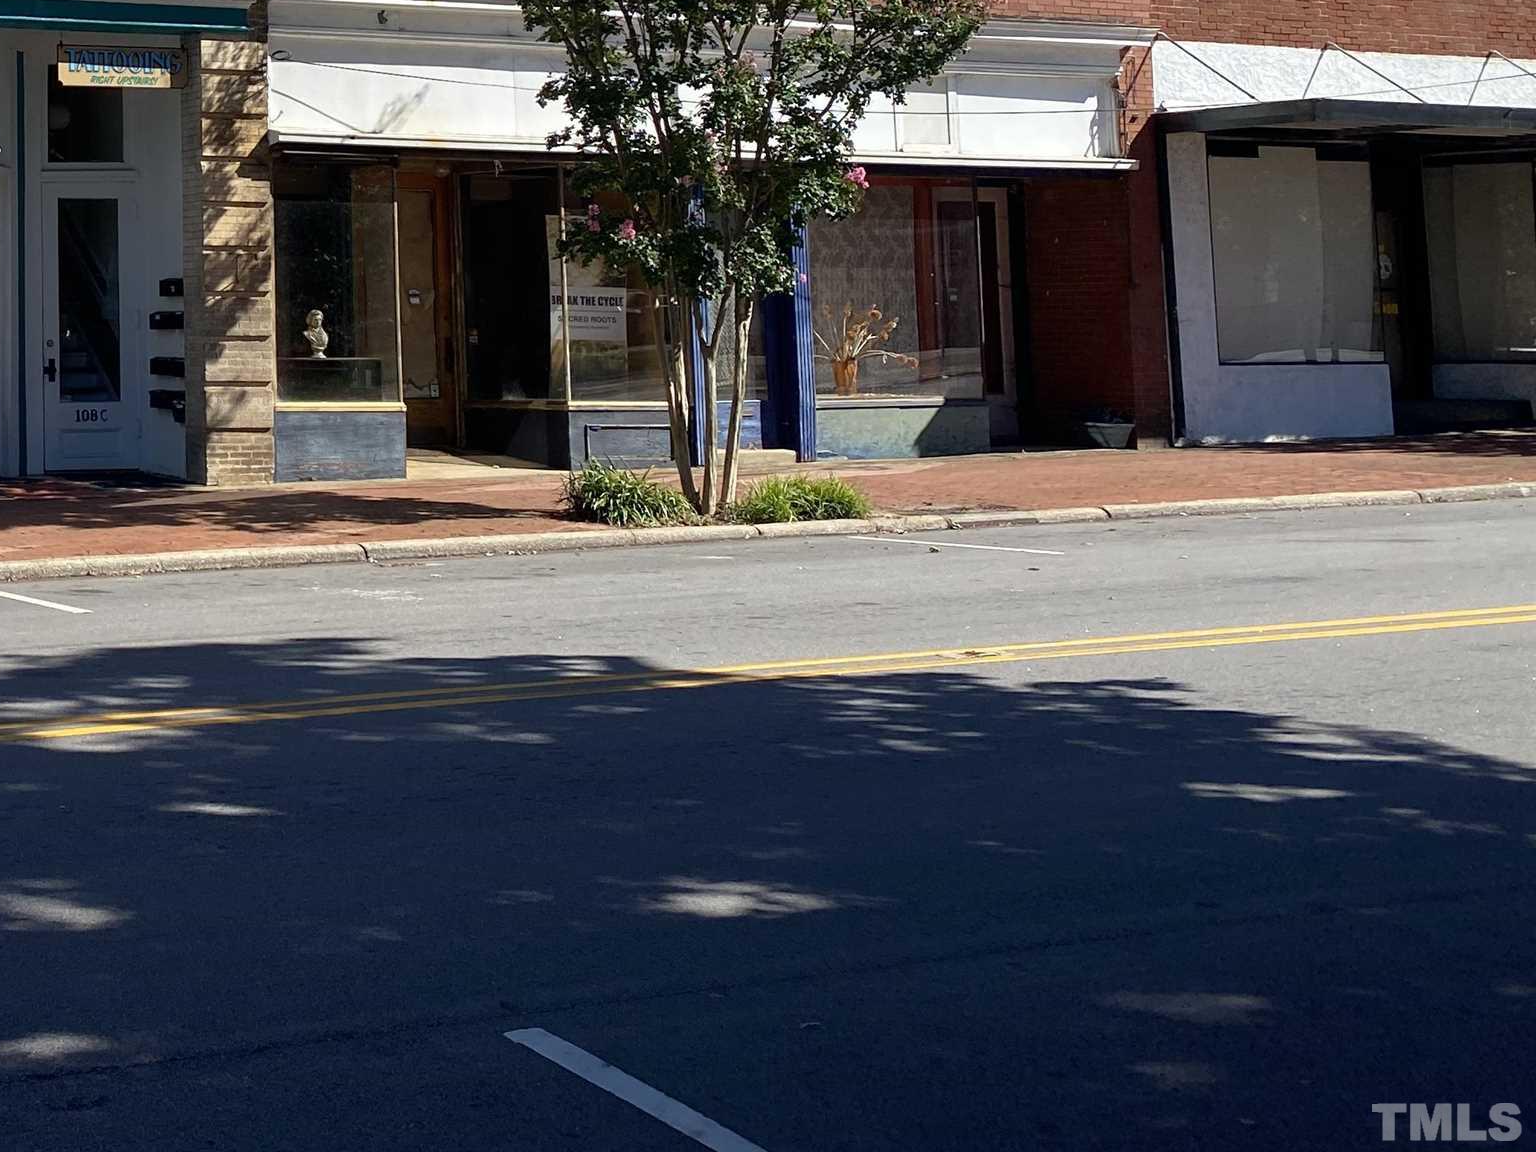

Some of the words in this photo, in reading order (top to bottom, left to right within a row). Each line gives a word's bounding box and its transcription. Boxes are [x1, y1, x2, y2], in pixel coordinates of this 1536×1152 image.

[65, 48, 181, 74] TATTOOING
[90, 75, 115, 85] RIGHT
[551, 295, 579, 306] BRAK
[579, 296, 596, 307] THE
[557, 315, 589, 323] SCRED
